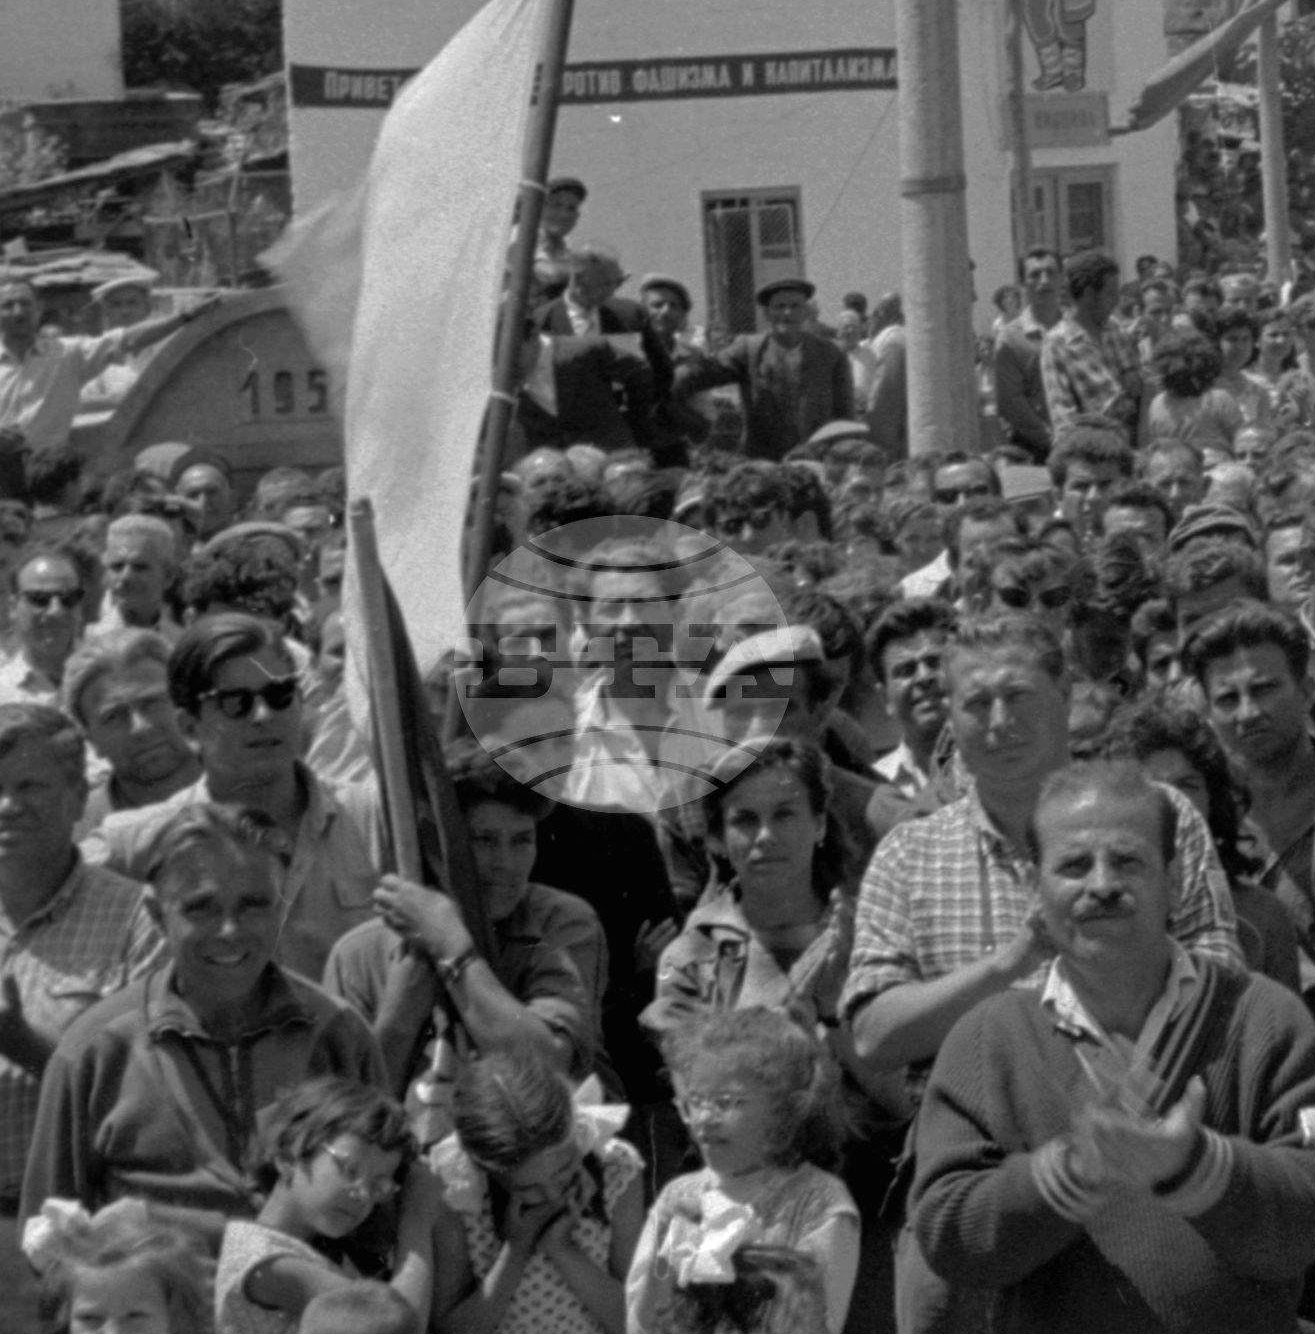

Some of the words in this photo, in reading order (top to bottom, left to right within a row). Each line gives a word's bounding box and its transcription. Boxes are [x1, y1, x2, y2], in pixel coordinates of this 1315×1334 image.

[563, 71, 622, 97] РОТИВ
[632, 64, 732, 93] ФАШИЗМА
[742, 62, 754, 87] И
[240, 369, 329, 417] 195
